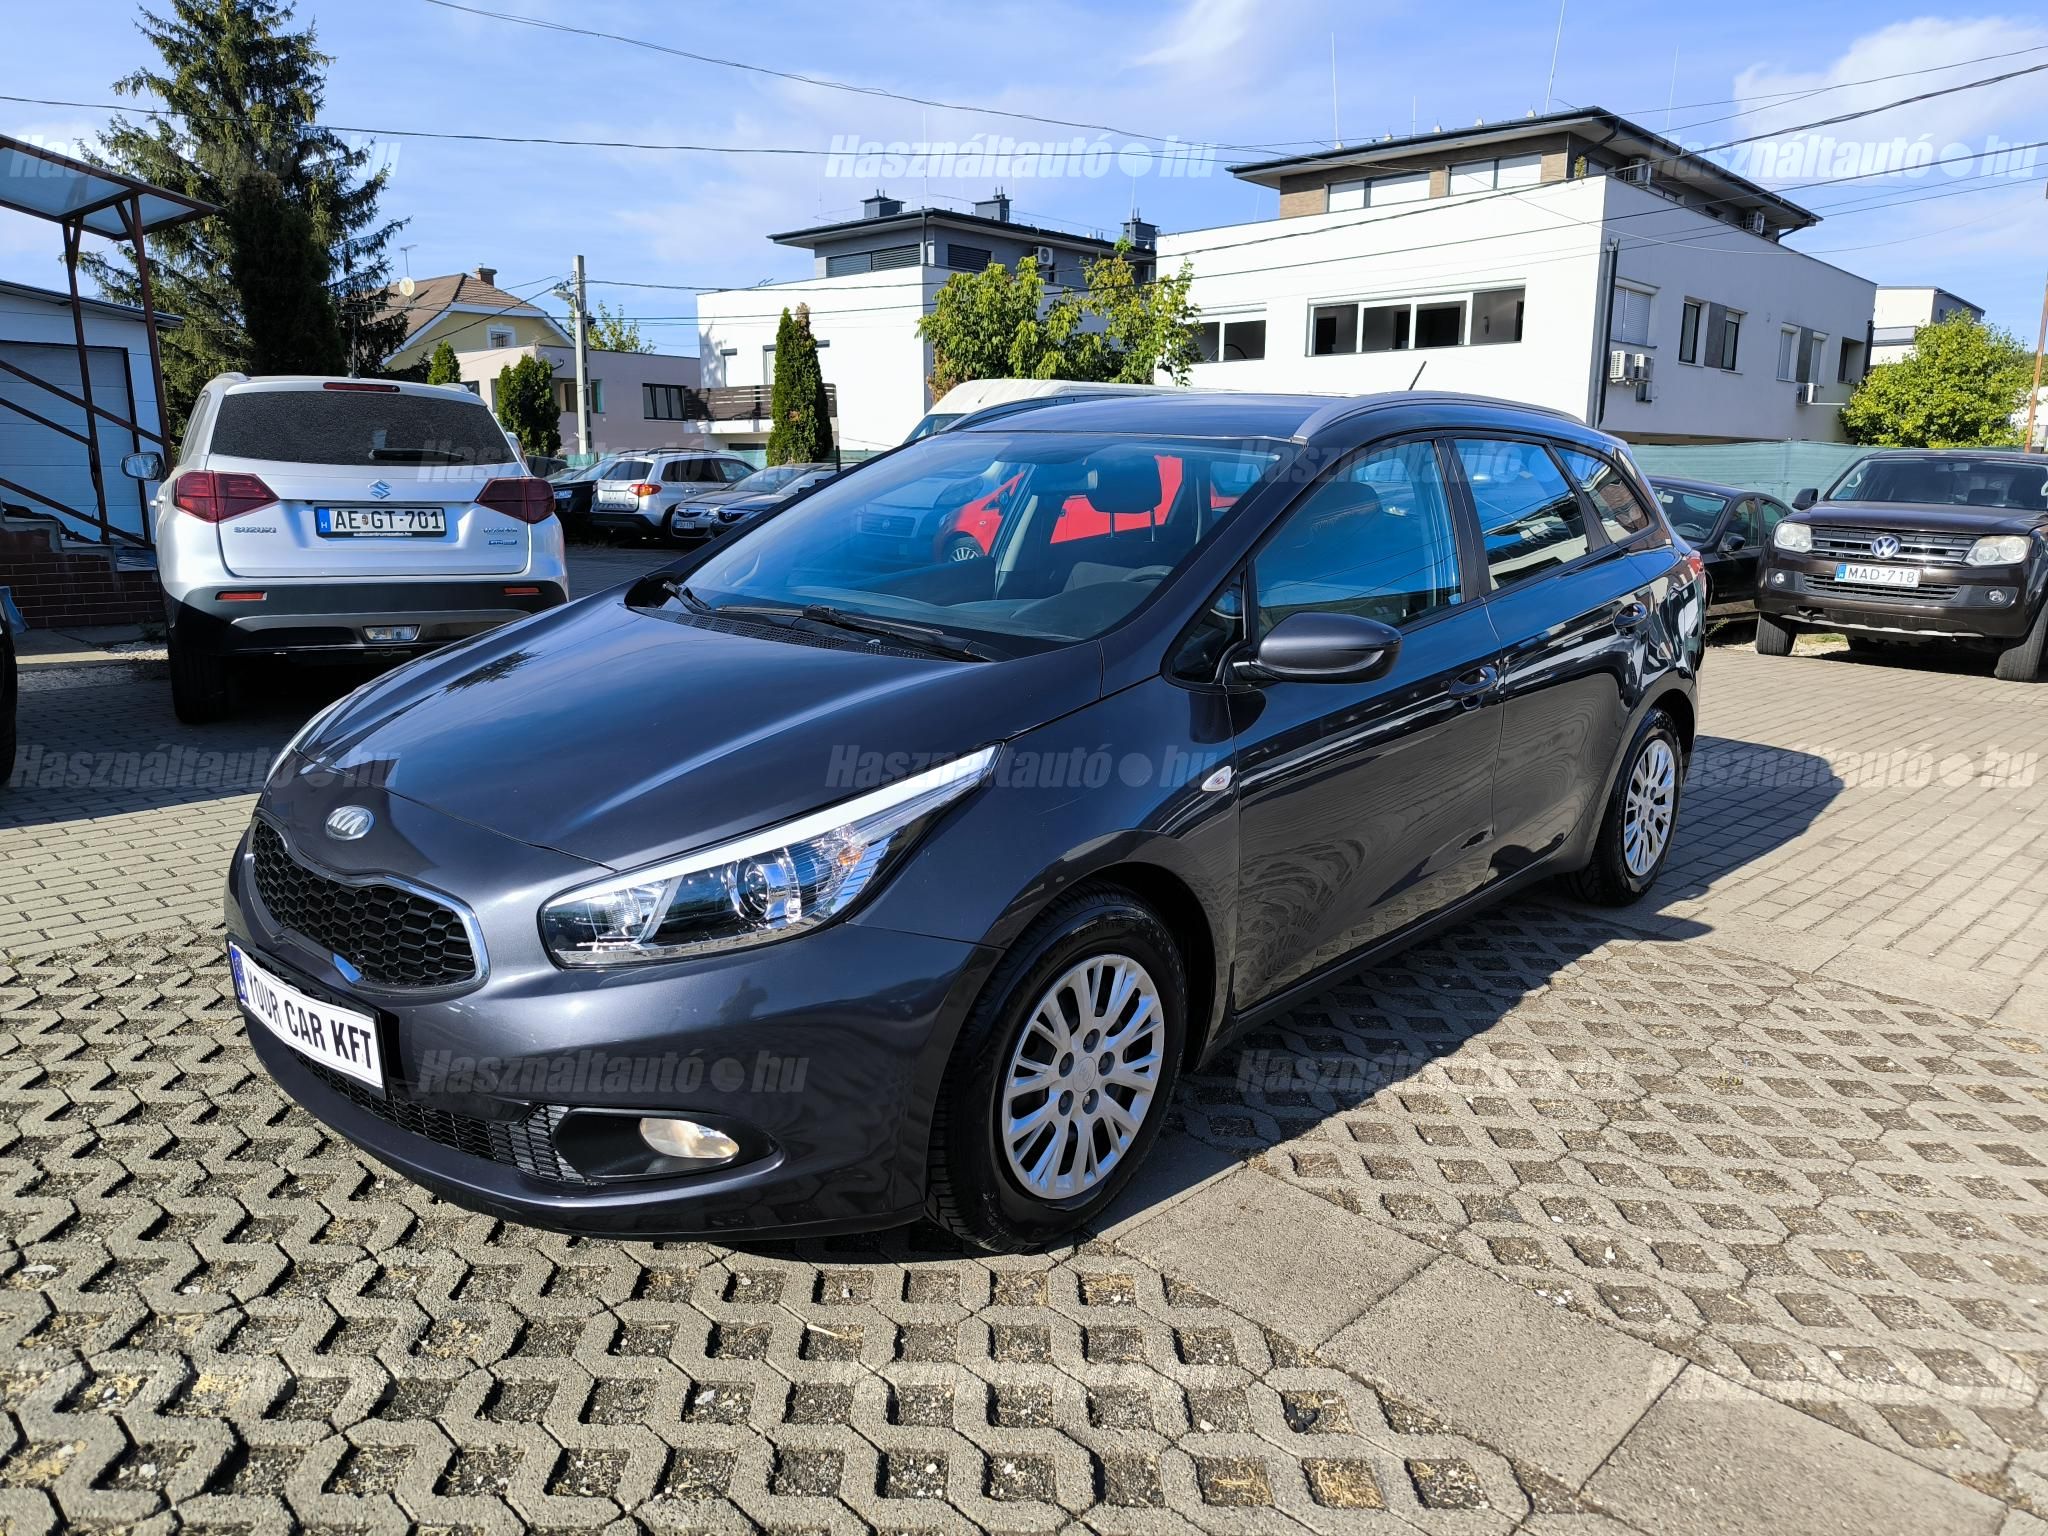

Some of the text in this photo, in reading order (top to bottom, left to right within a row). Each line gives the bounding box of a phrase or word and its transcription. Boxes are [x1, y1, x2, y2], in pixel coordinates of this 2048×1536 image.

[370, 510, 441, 529] GT-701
[1848, 567, 1915, 583] MAD-718
[327, 809, 367, 836] KIA
[245, 966, 283, 1029] YOUR
[284, 999, 327, 1051] CAR
[330, 1018, 372, 1070] KFT
